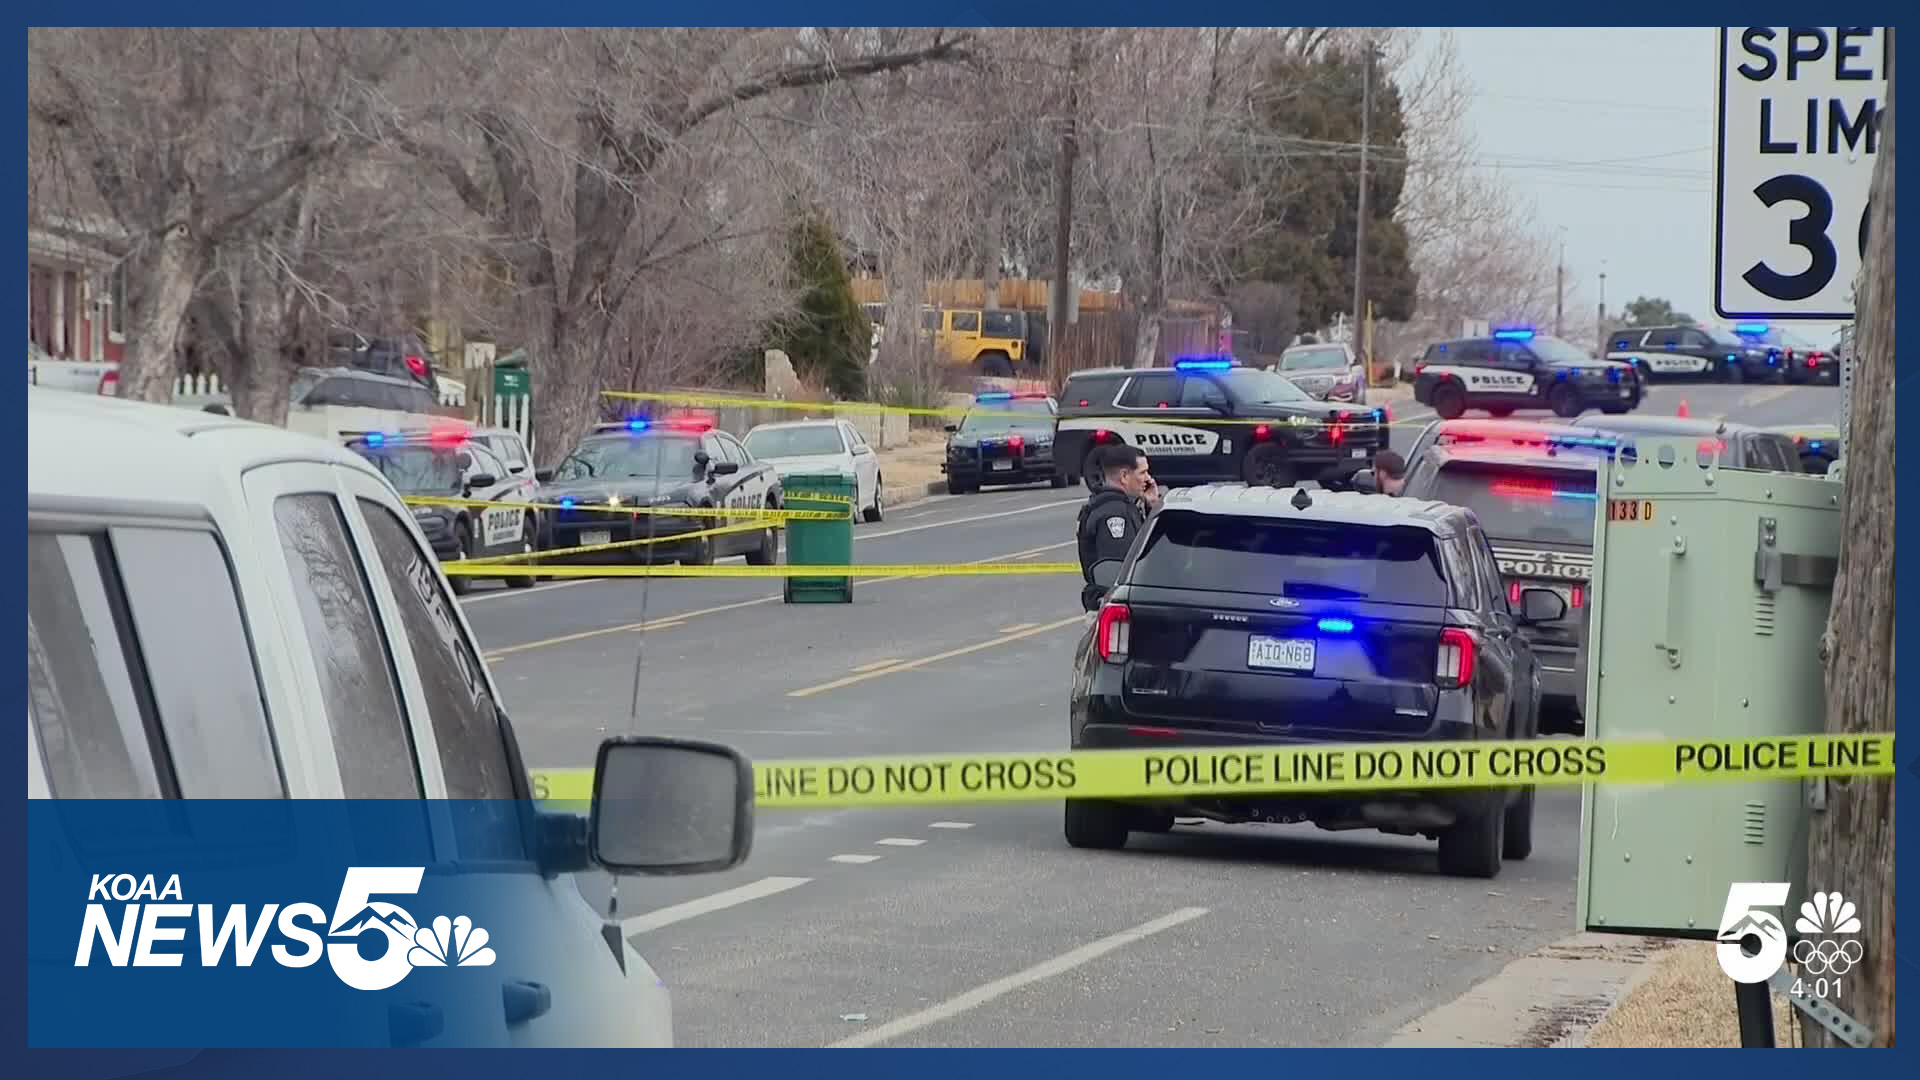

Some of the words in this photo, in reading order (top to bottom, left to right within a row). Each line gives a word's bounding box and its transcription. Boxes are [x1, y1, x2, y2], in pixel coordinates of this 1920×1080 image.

[1737, 27, 1887, 81] SPE
[1759, 98, 1877, 154] LIM
[1742, 174, 1871, 301] 3
[1471, 375, 1525, 384] POLICE
[1135, 433, 1207, 445] POLICE
[488, 508, 521, 530] POLICE
[1644, 502, 1652, 521] D
[1144, 754, 1264, 784] POLICE
[1273, 751, 1345, 782] LINE
[1355, 750, 1402, 780] DO
[1412, 749, 1480, 778] NOT
[1489, 746, 1606, 776] CROSS
[1675, 741, 1798, 772] POLICE
[1808, 740, 1881, 767] LINE
[828, 766, 875, 794] DO
[885, 763, 952, 793] NOT
[961, 758, 1077, 791] CROSS
